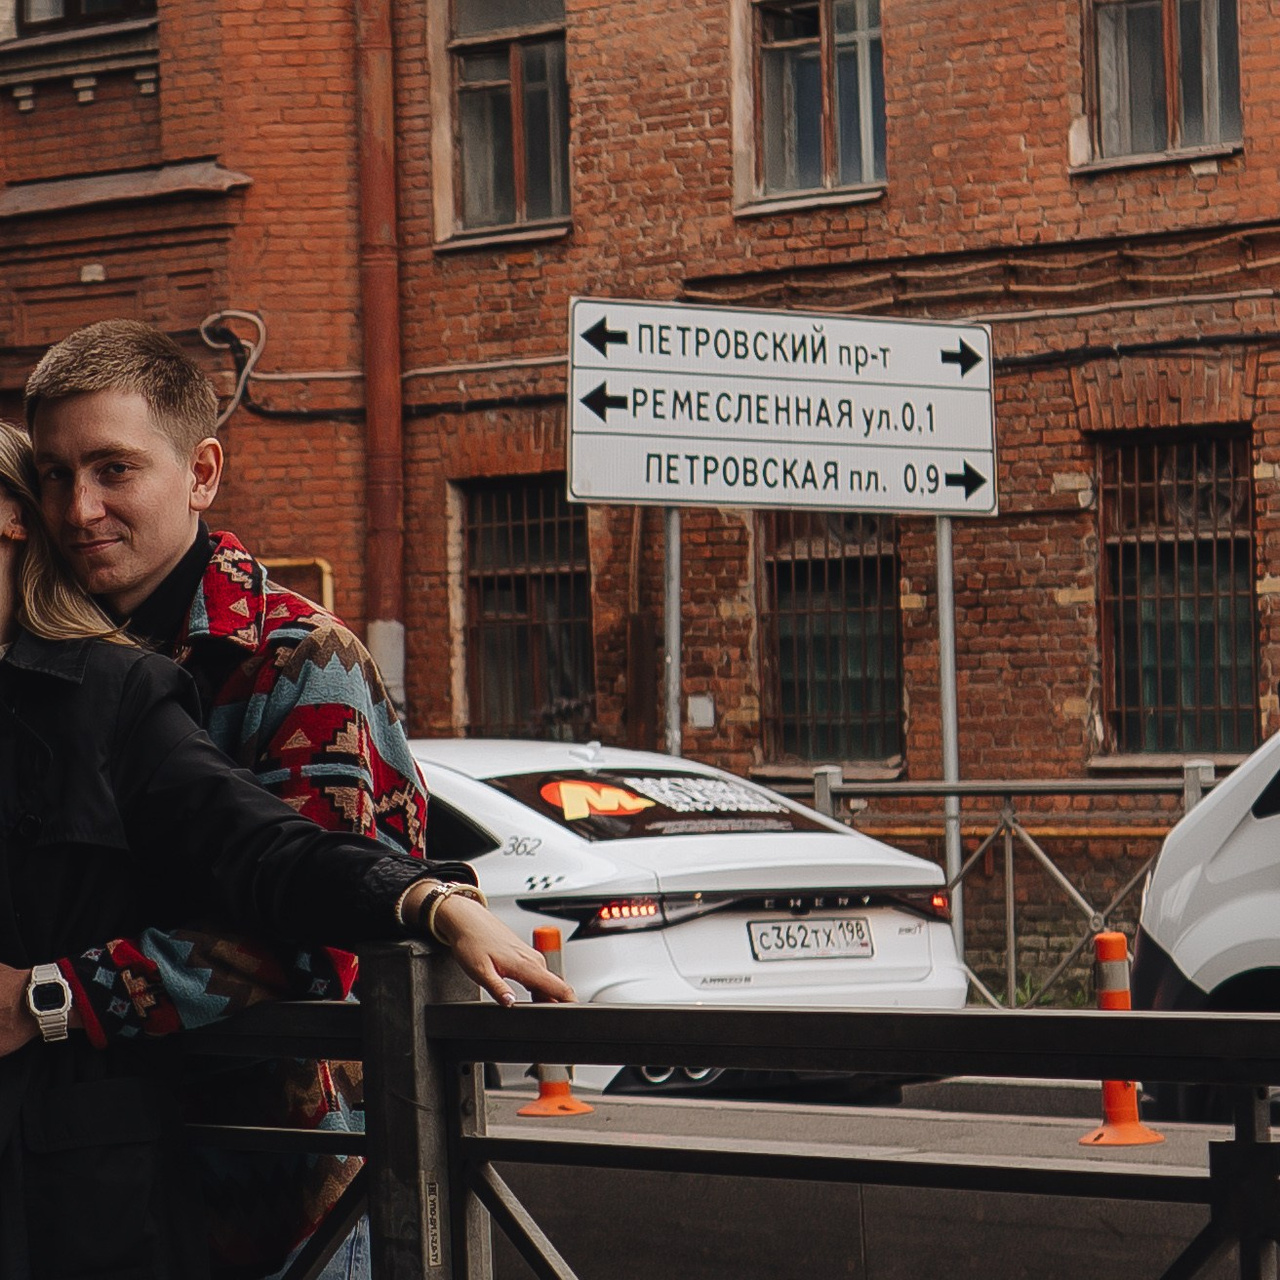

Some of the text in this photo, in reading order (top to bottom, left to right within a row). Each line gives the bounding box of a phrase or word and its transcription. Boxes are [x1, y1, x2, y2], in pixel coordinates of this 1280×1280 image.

[638, 324, 891, 375] ПЕТРОВСКИЙ пр-т
[632, 387, 853, 428] РЕМЕСЛЕННАЯ
[646, 453, 838, 490] ПЕТРОВСКАЯ
[850, 469, 886, 493] пл.
[503, 835, 542, 856] 362
[760, 921, 865, 950] С362ТХ 198
